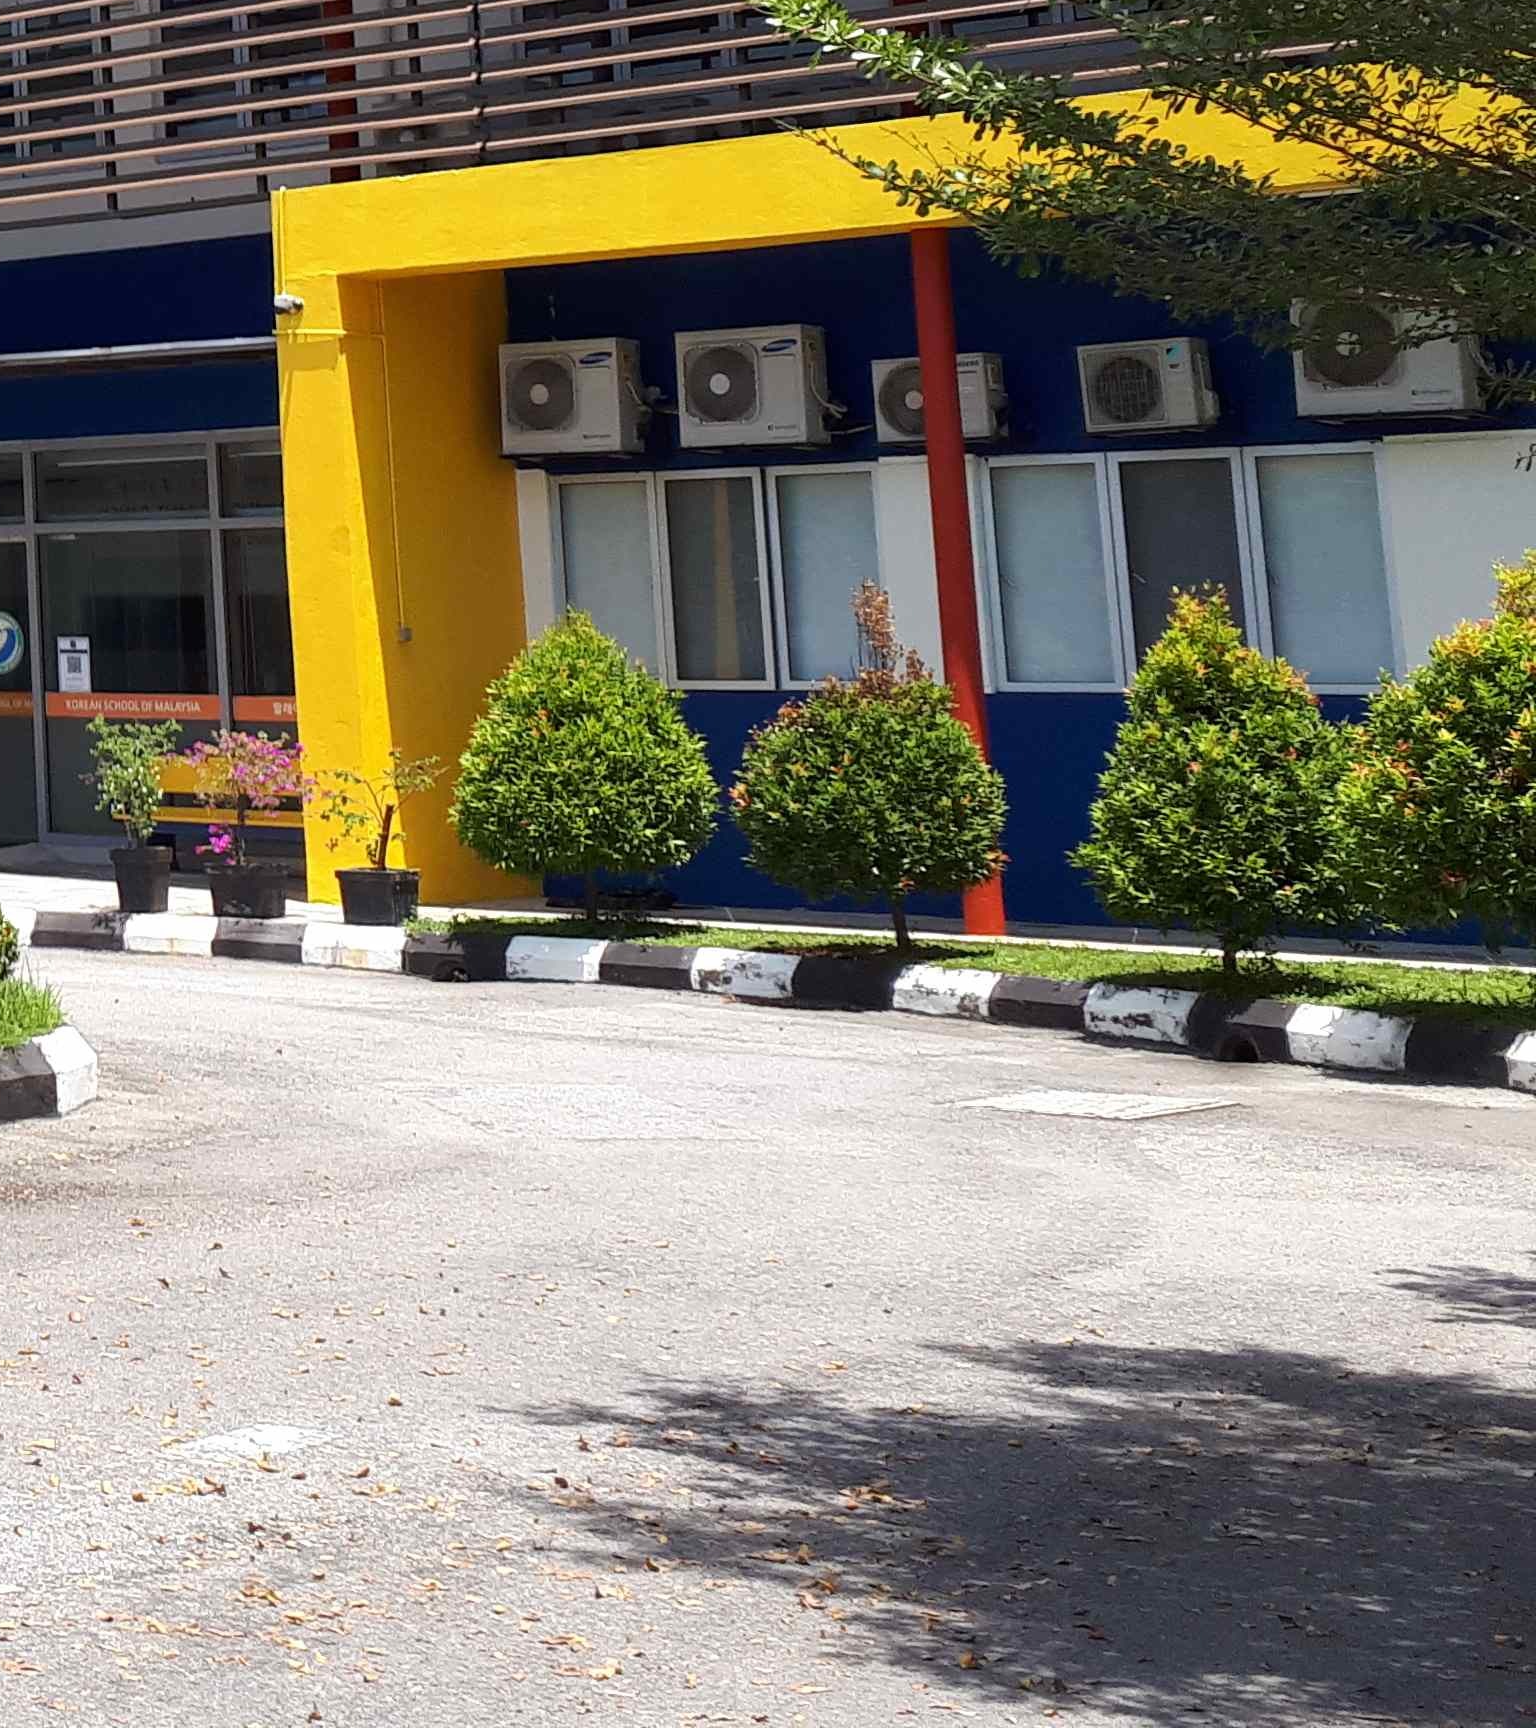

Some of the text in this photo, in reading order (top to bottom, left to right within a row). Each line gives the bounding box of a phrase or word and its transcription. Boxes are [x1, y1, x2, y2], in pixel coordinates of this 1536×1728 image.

[64, 699, 201, 713] KOREAN SCHOOL OF MALAYSIA
